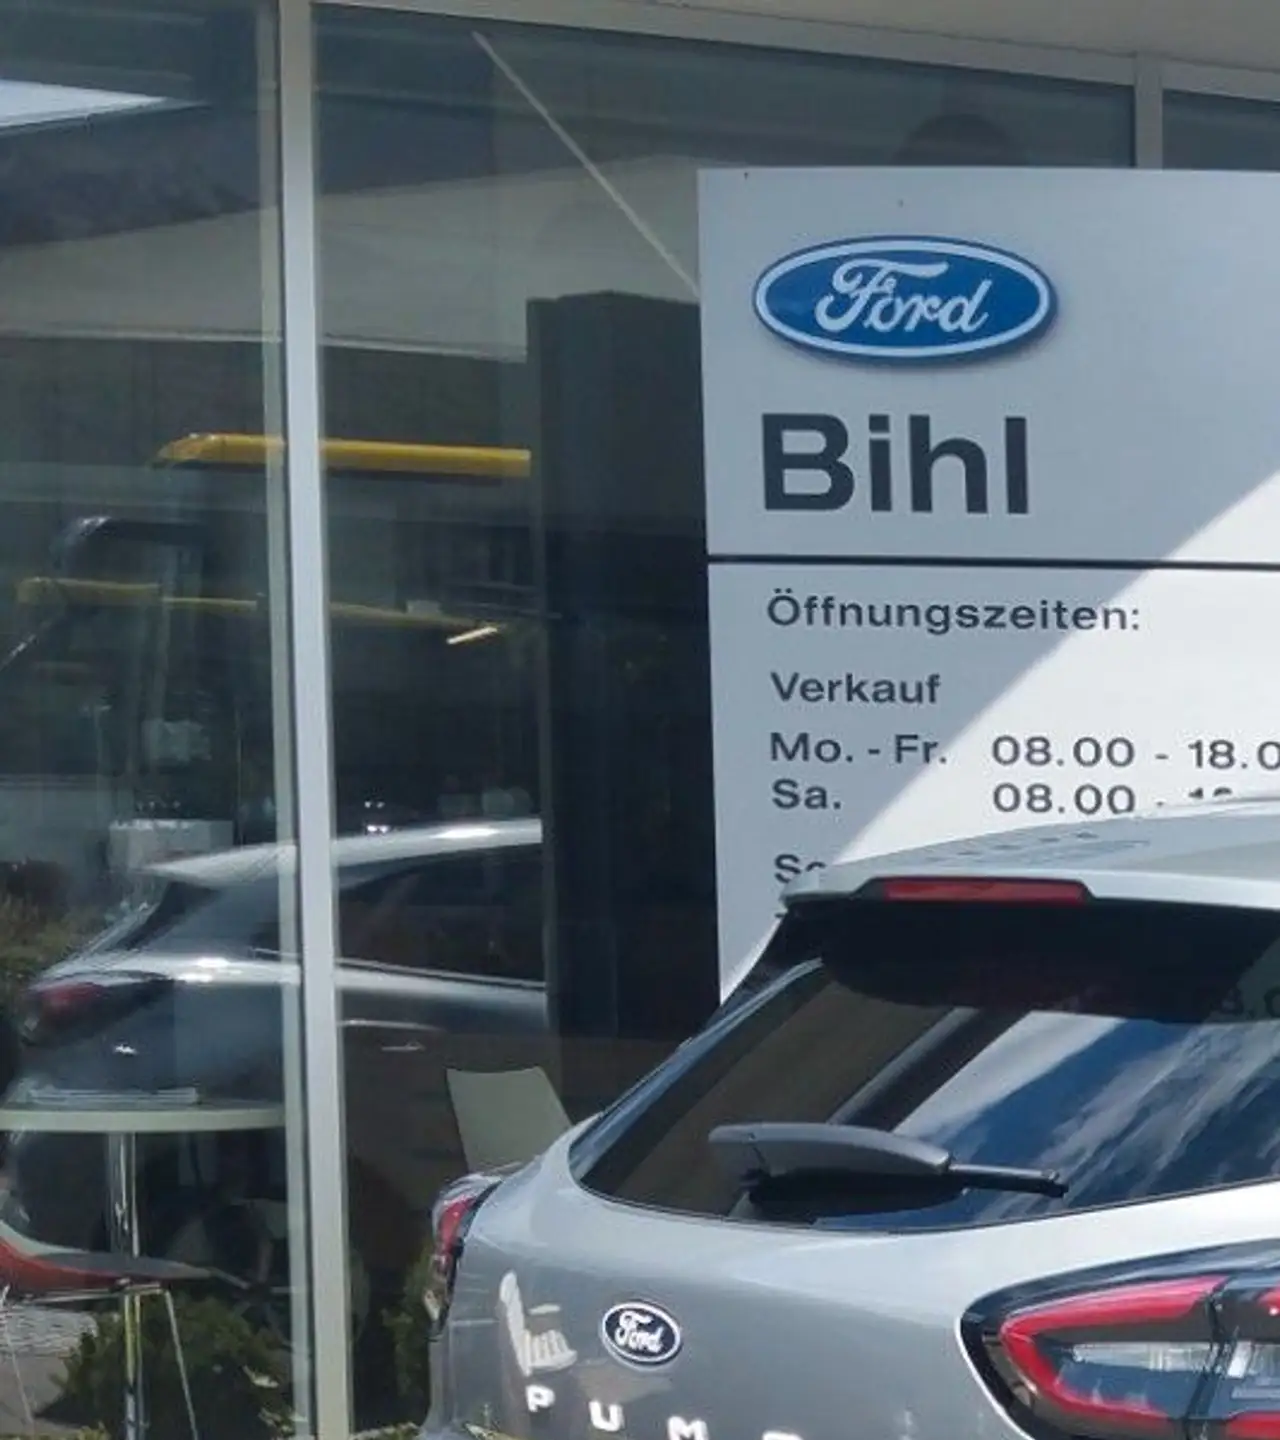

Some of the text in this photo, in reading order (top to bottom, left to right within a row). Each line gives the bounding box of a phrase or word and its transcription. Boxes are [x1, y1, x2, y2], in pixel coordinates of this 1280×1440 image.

[814, 257, 993, 333] Ford
[761, 412, 1029, 515] Bihl
[766, 587, 1140, 635] Öffnungszeiten:
[770, 671, 942, 705] Verkauf
[770, 731, 854, 764] Mo.
[894, 734, 948, 764] Fr.
[991, 734, 1136, 768] 08.00
[771, 778, 842, 811] Sa.
[992, 782, 1136, 814] 08.00
